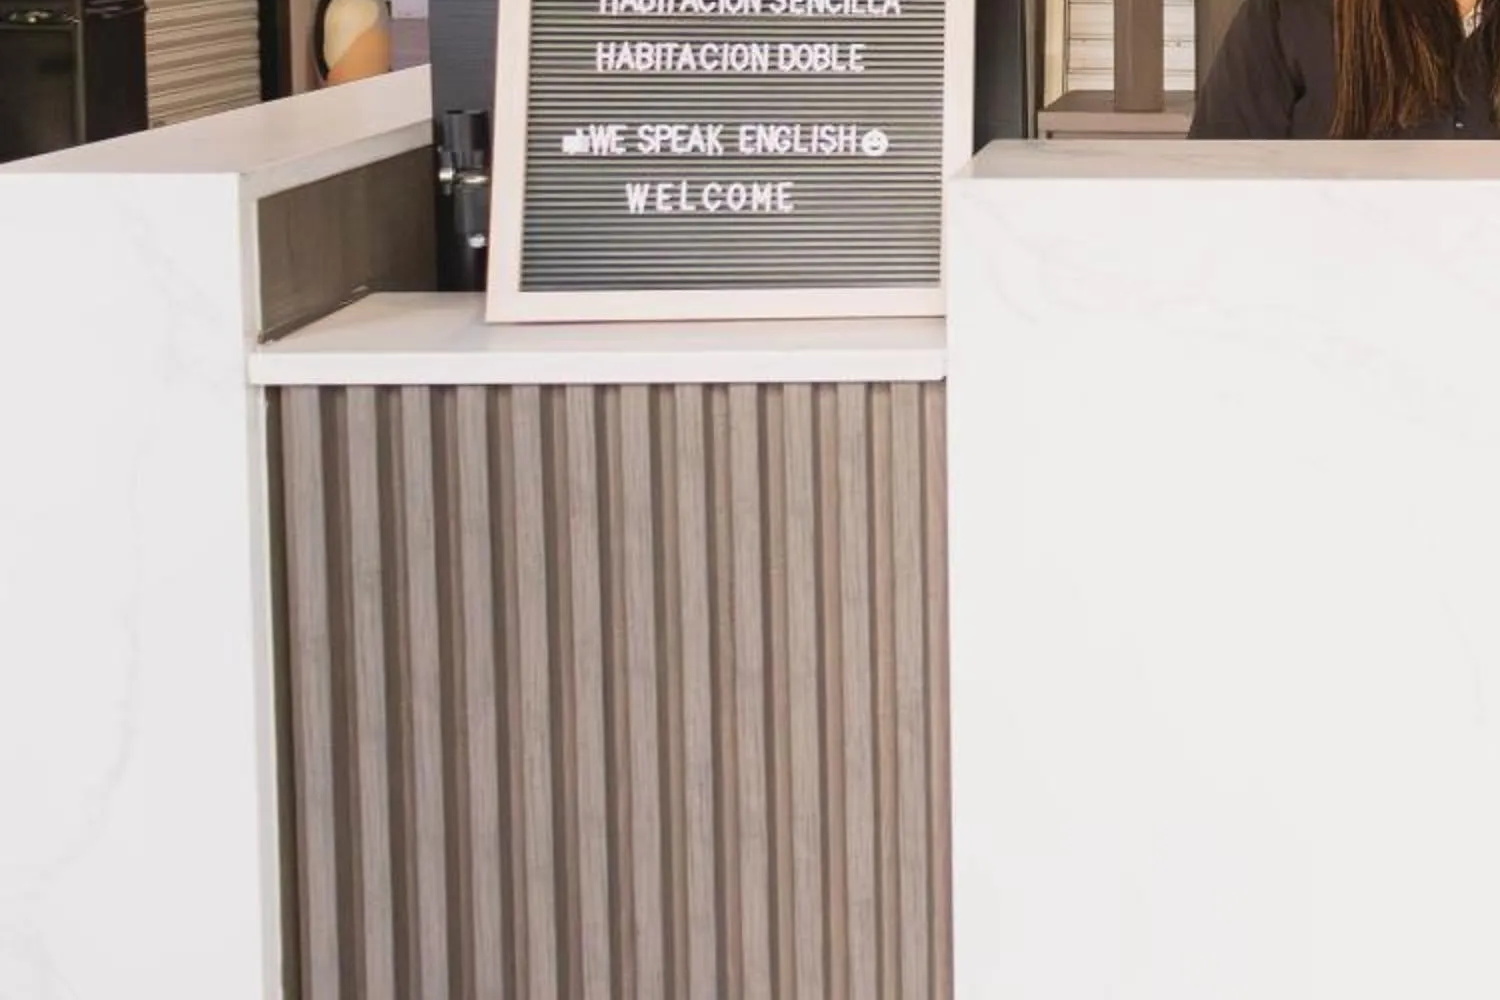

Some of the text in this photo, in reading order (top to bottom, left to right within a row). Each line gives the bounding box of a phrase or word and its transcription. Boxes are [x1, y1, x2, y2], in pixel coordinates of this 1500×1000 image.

[596, 41, 866, 73] HABITACION DOBLE
[588, 124, 857, 155] WE SPEAK ENGLISH
[625, 180, 795, 214] WELCOME
